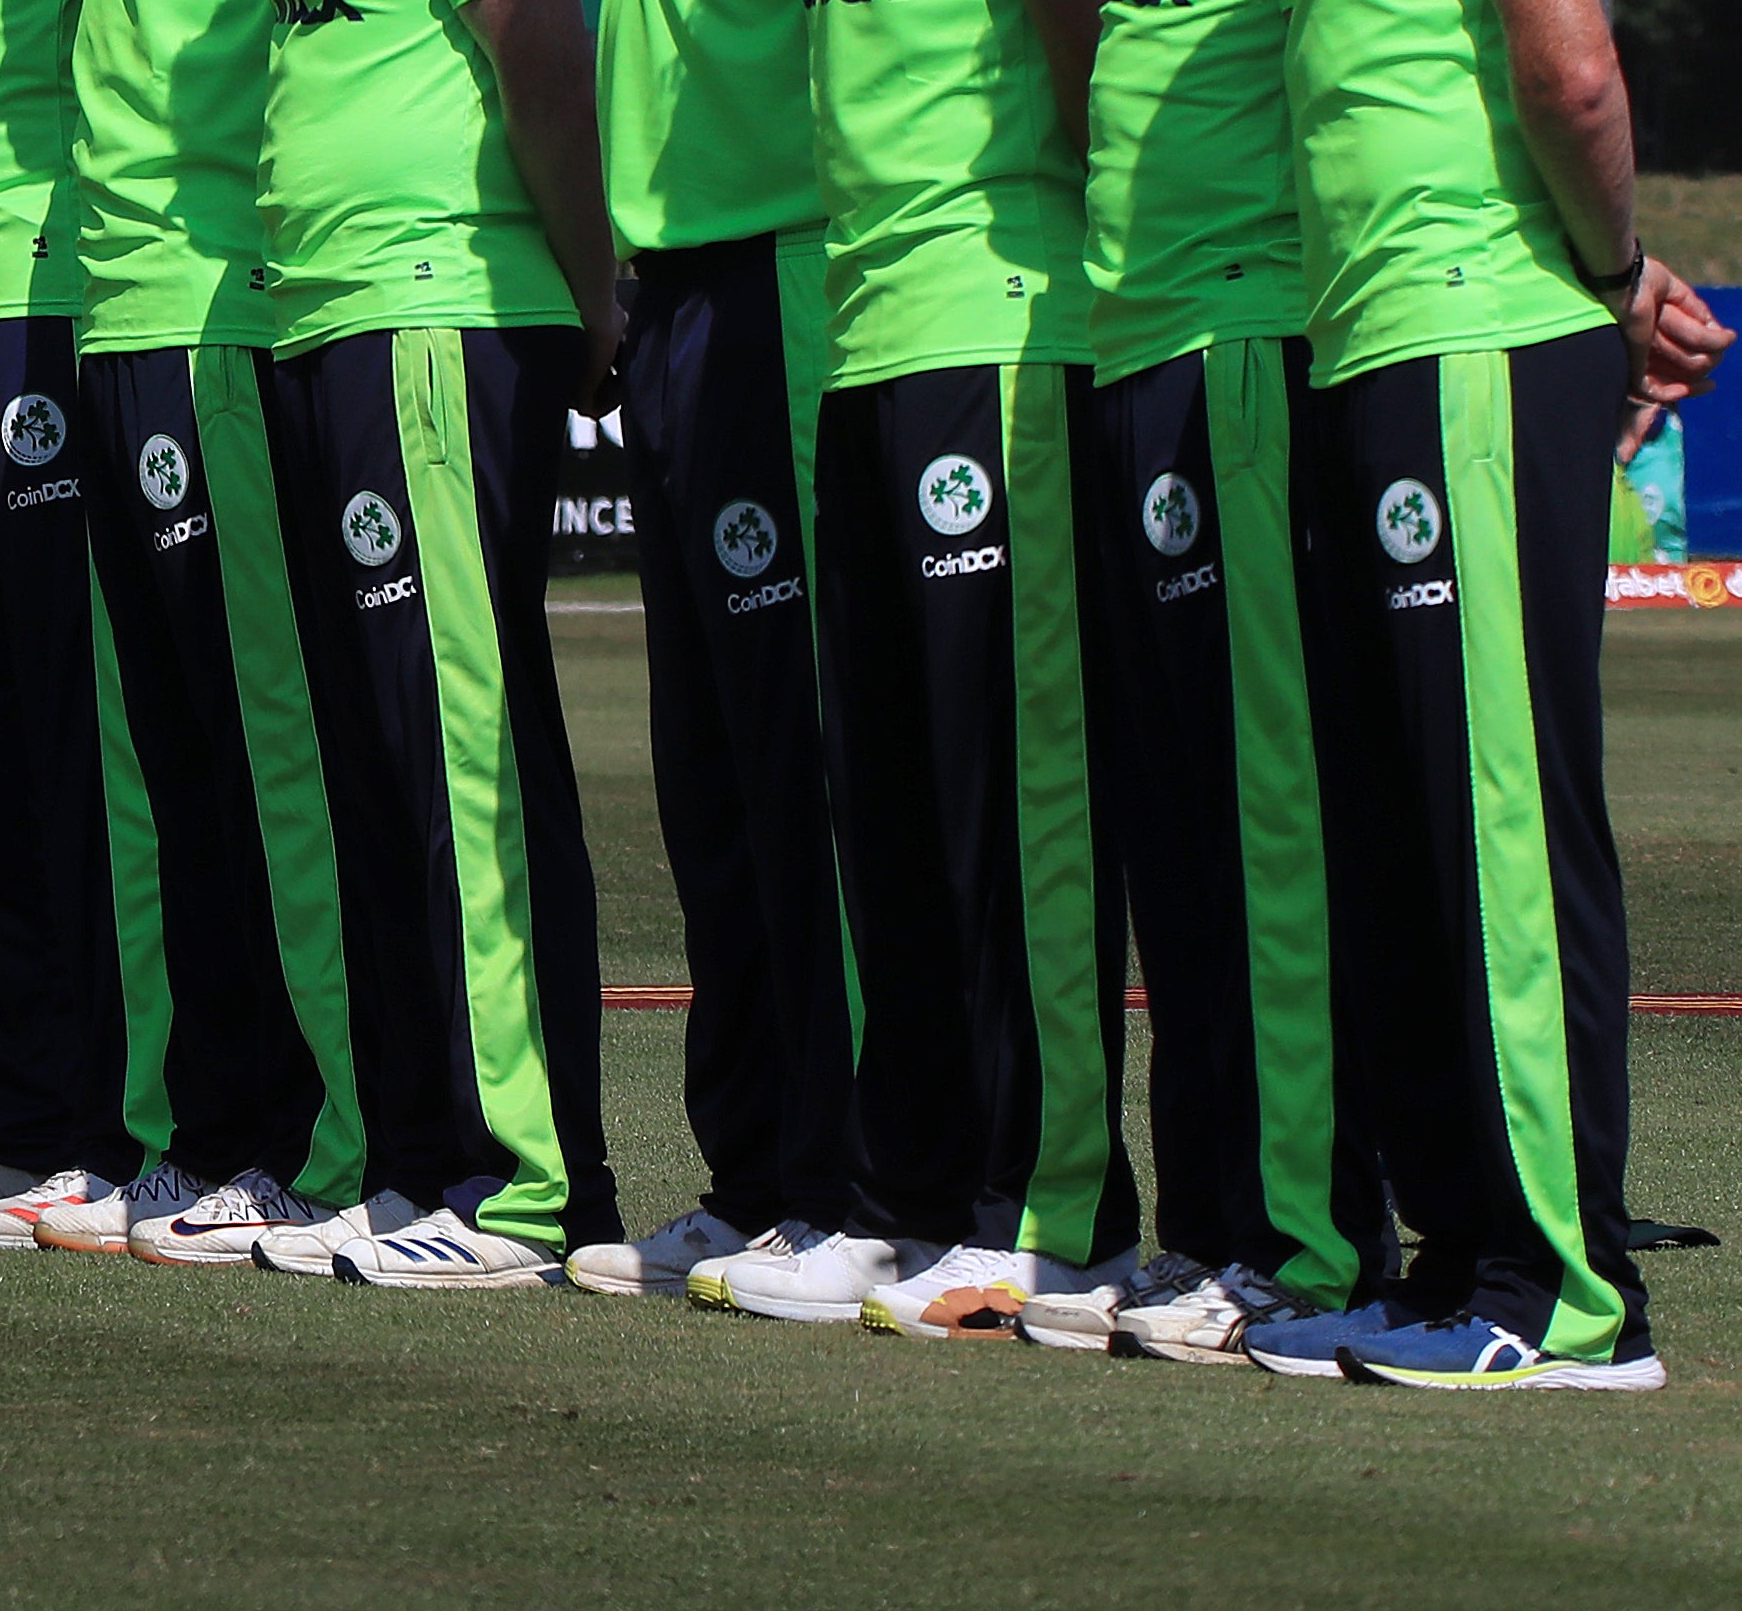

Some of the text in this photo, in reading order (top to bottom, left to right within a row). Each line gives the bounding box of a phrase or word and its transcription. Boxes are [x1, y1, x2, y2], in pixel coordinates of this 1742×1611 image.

[7, 476, 83, 512] CoinDCX
[921, 542, 1007, 581] CoinDCX
[726, 575, 805, 615] CoinDCX
